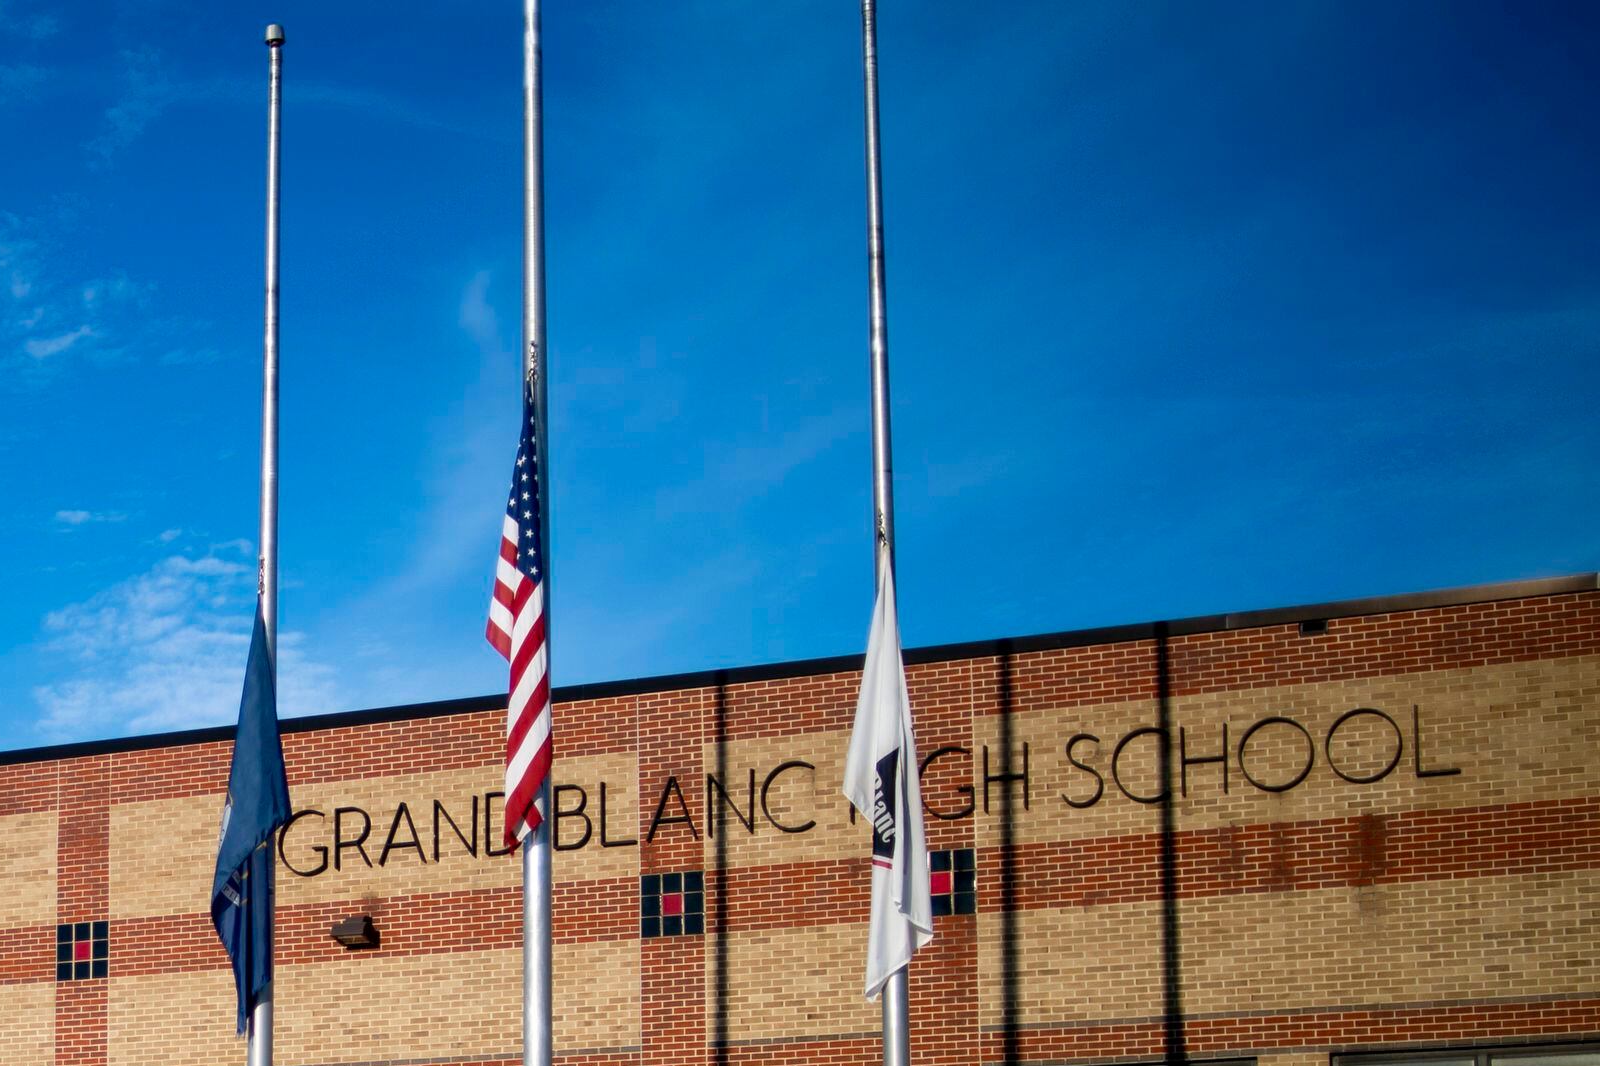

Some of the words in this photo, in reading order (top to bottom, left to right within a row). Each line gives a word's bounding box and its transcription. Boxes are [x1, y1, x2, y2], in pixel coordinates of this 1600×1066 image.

[278, 792, 523, 877] GRAND
[552, 760, 816, 851] BLANC
[849, 742, 1030, 826] GH
[1061, 703, 1462, 809] SCHOOL
